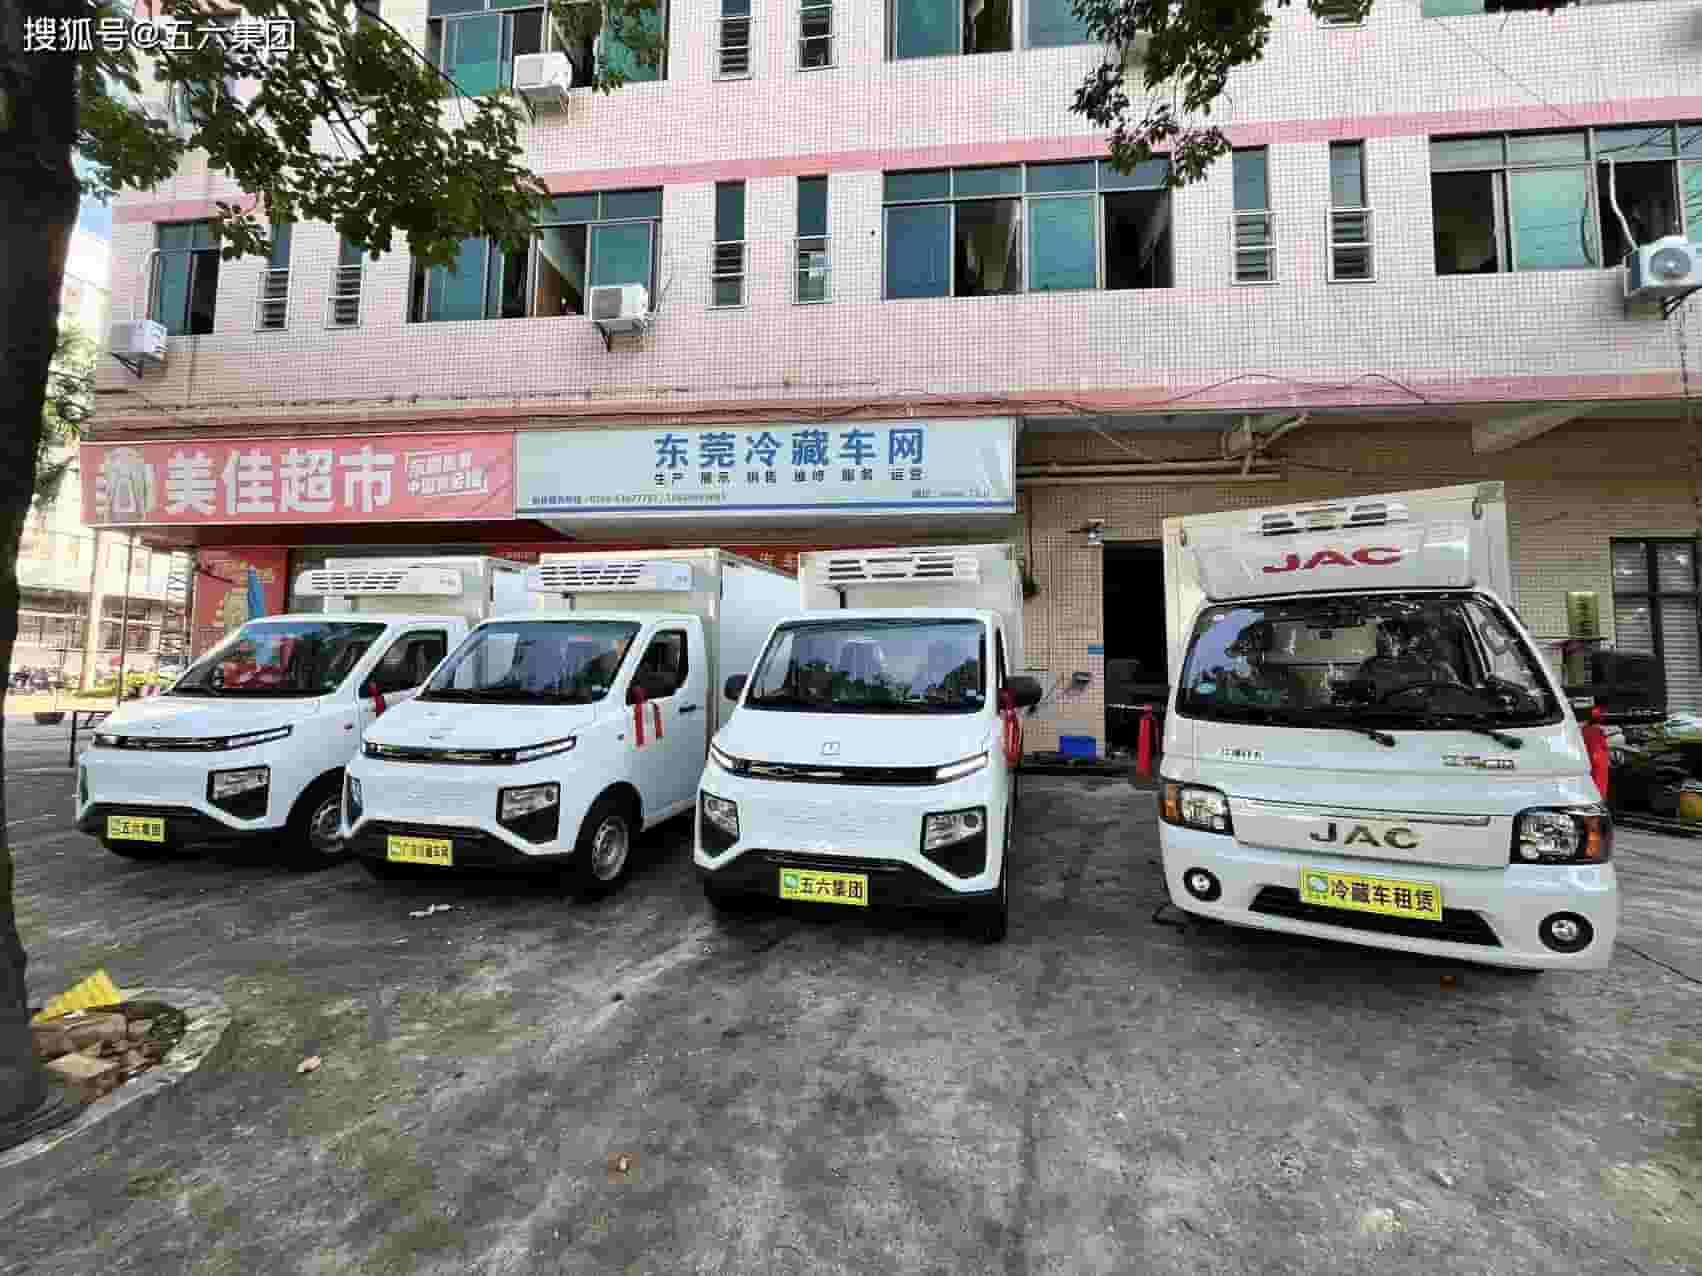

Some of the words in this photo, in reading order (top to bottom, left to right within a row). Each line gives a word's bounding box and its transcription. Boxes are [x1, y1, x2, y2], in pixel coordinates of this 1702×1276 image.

[653, 427, 924, 469] 东莞冷藏车网
[165, 446, 396, 515] 美佳超市
[1262, 547, 1402, 574] JAC
[1309, 822, 1419, 849] JAC
[800, 877, 864, 898] 五六集团
[1330, 879, 1433, 913] 冷藏车租赁
